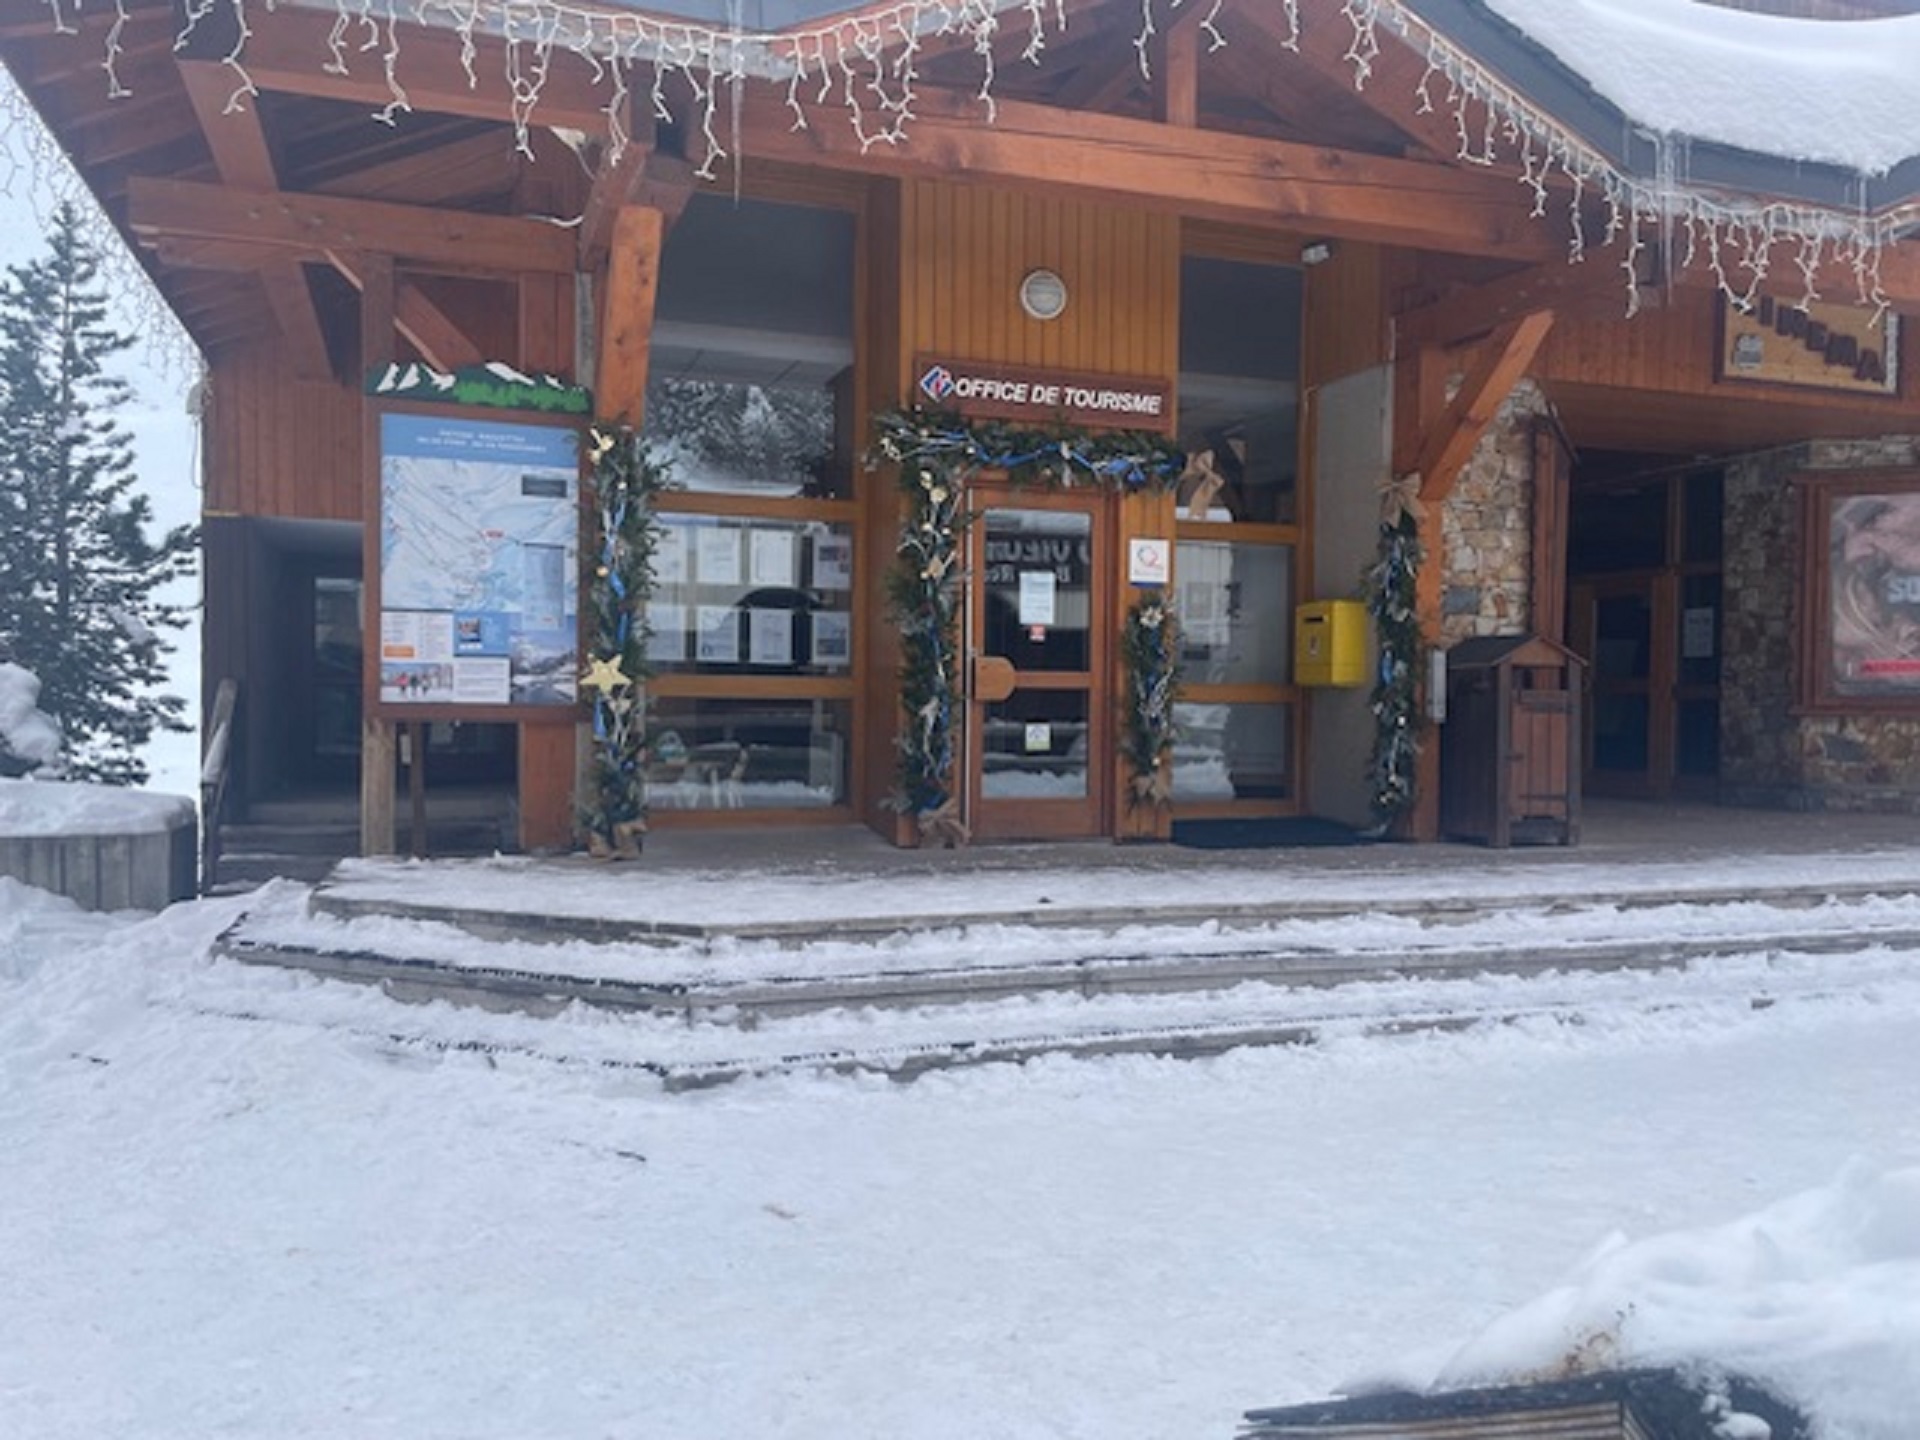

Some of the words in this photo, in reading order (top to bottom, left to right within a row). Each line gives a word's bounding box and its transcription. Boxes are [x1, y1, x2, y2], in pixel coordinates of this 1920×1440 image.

[955, 377, 1028, 404] OFFICE
[1030, 384, 1060, 405] DE
[1063, 387, 1162, 415] TOURISME
